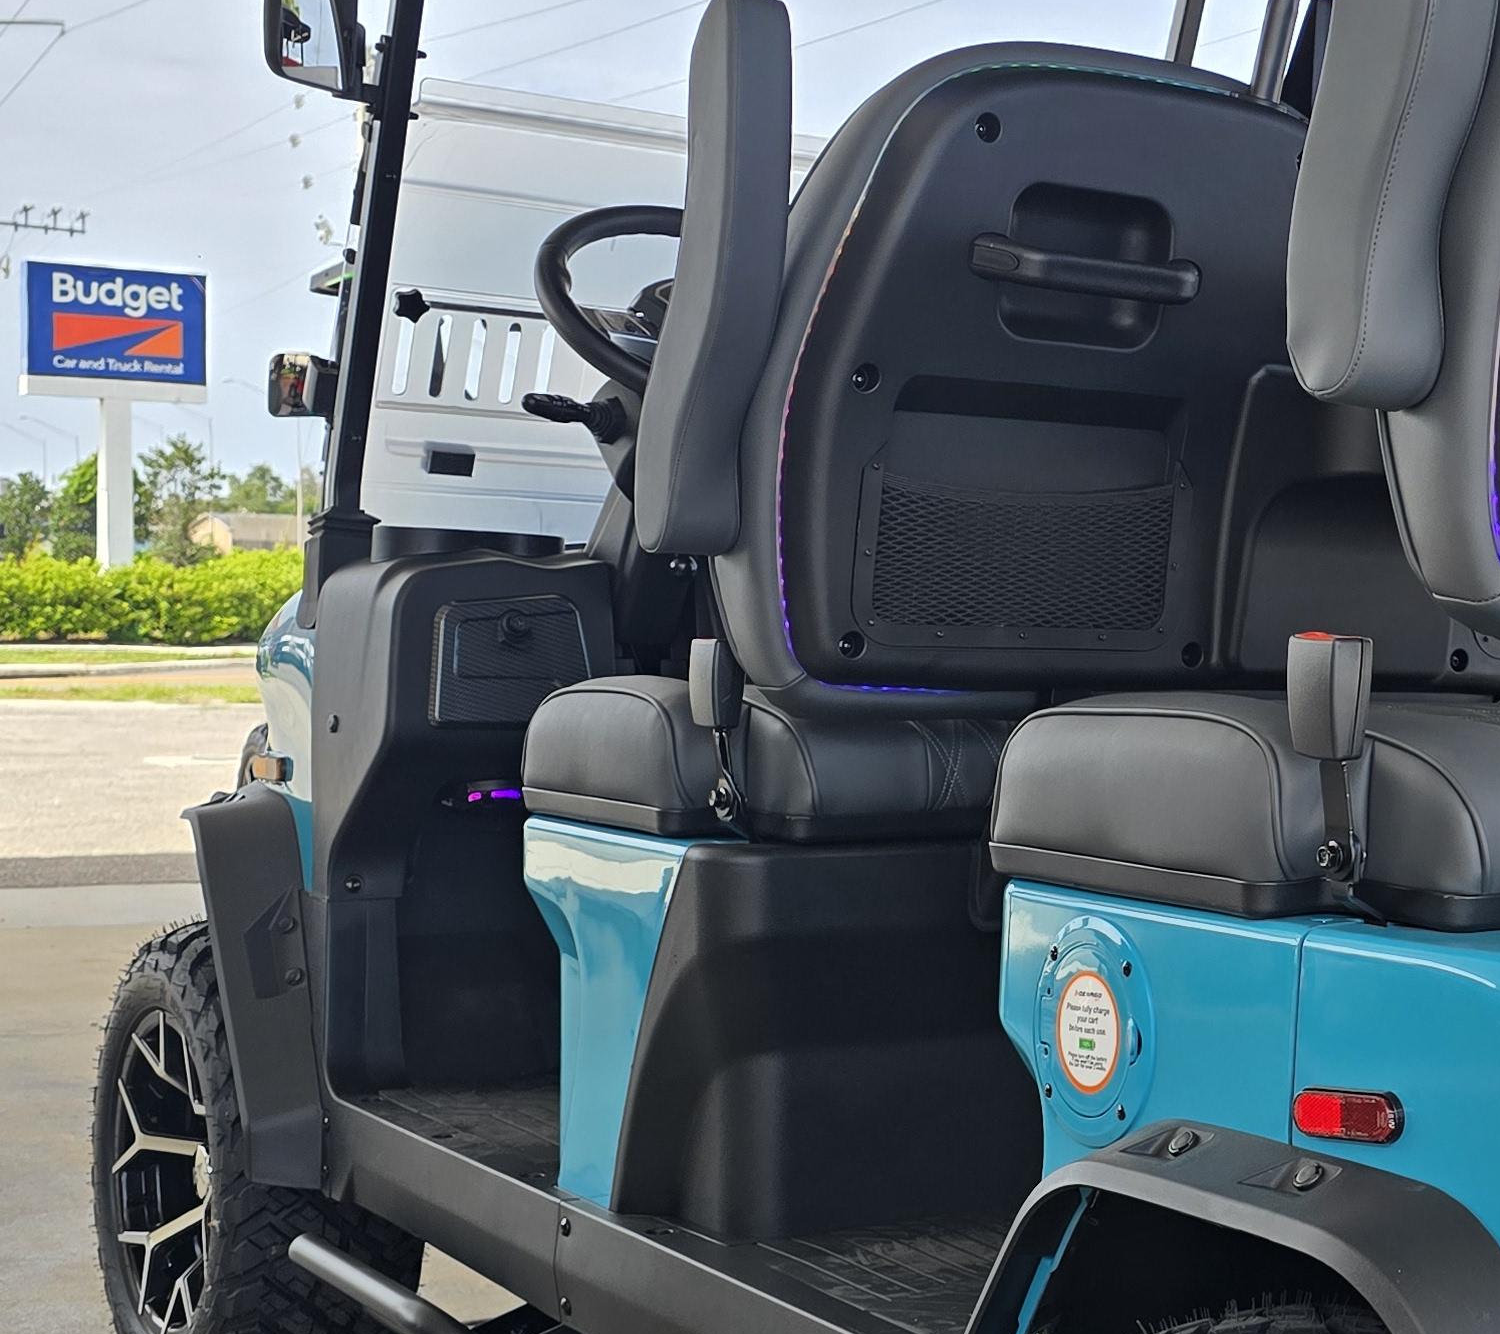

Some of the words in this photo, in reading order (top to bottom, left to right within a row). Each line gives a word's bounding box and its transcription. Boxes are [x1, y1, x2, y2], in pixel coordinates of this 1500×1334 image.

[52, 271, 184, 318] Budget
[53, 355, 76, 369] Car
[78, 357, 105, 371] and
[106, 358, 142, 372] Truck
[144, 360, 184, 375] Rental
